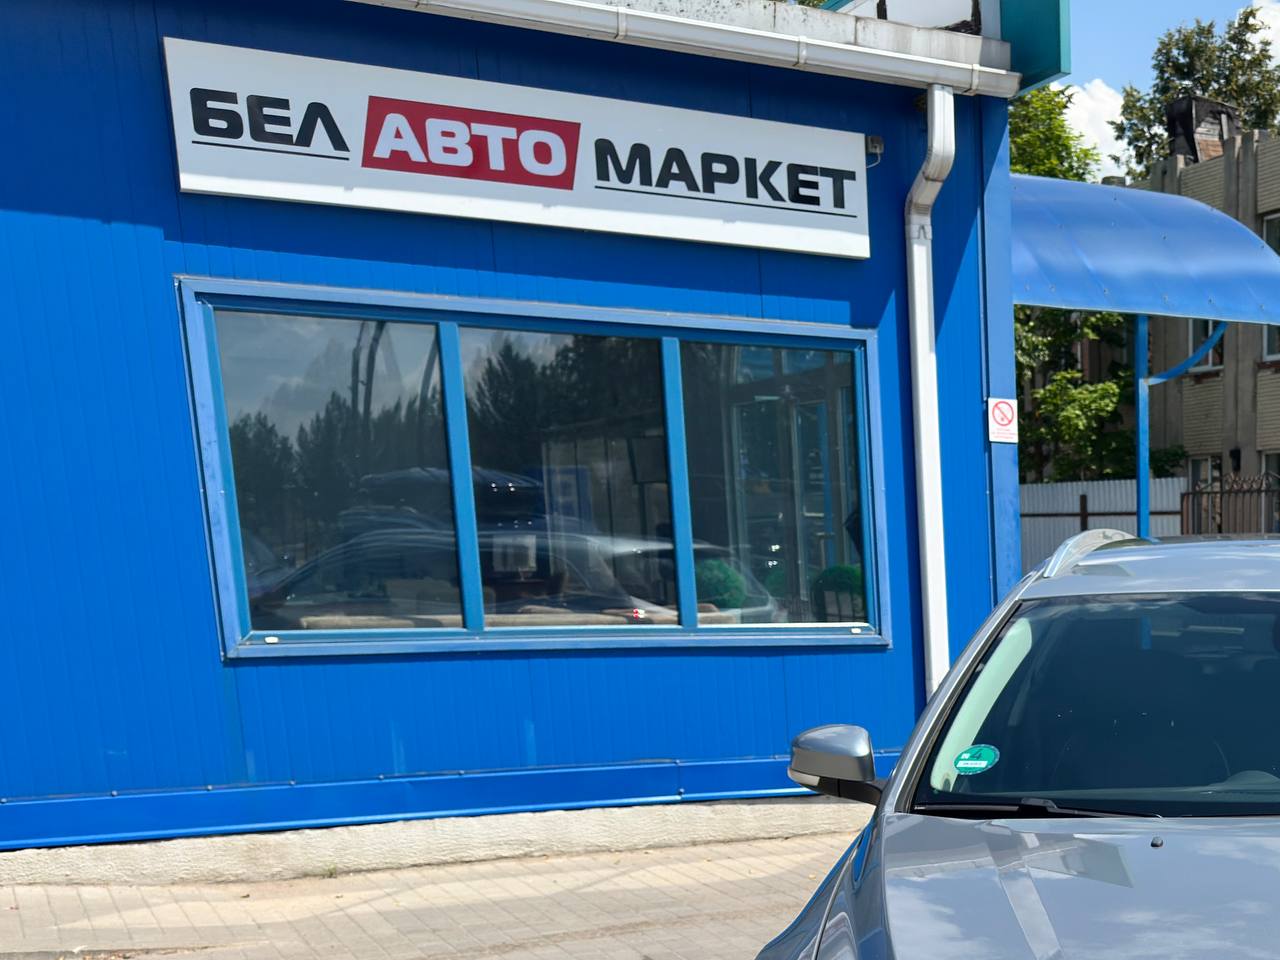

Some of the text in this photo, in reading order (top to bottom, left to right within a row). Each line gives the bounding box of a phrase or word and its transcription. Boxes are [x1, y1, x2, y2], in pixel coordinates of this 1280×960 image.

[189, 86, 856, 210] БЕЛ АВТО МАРКЕТ
